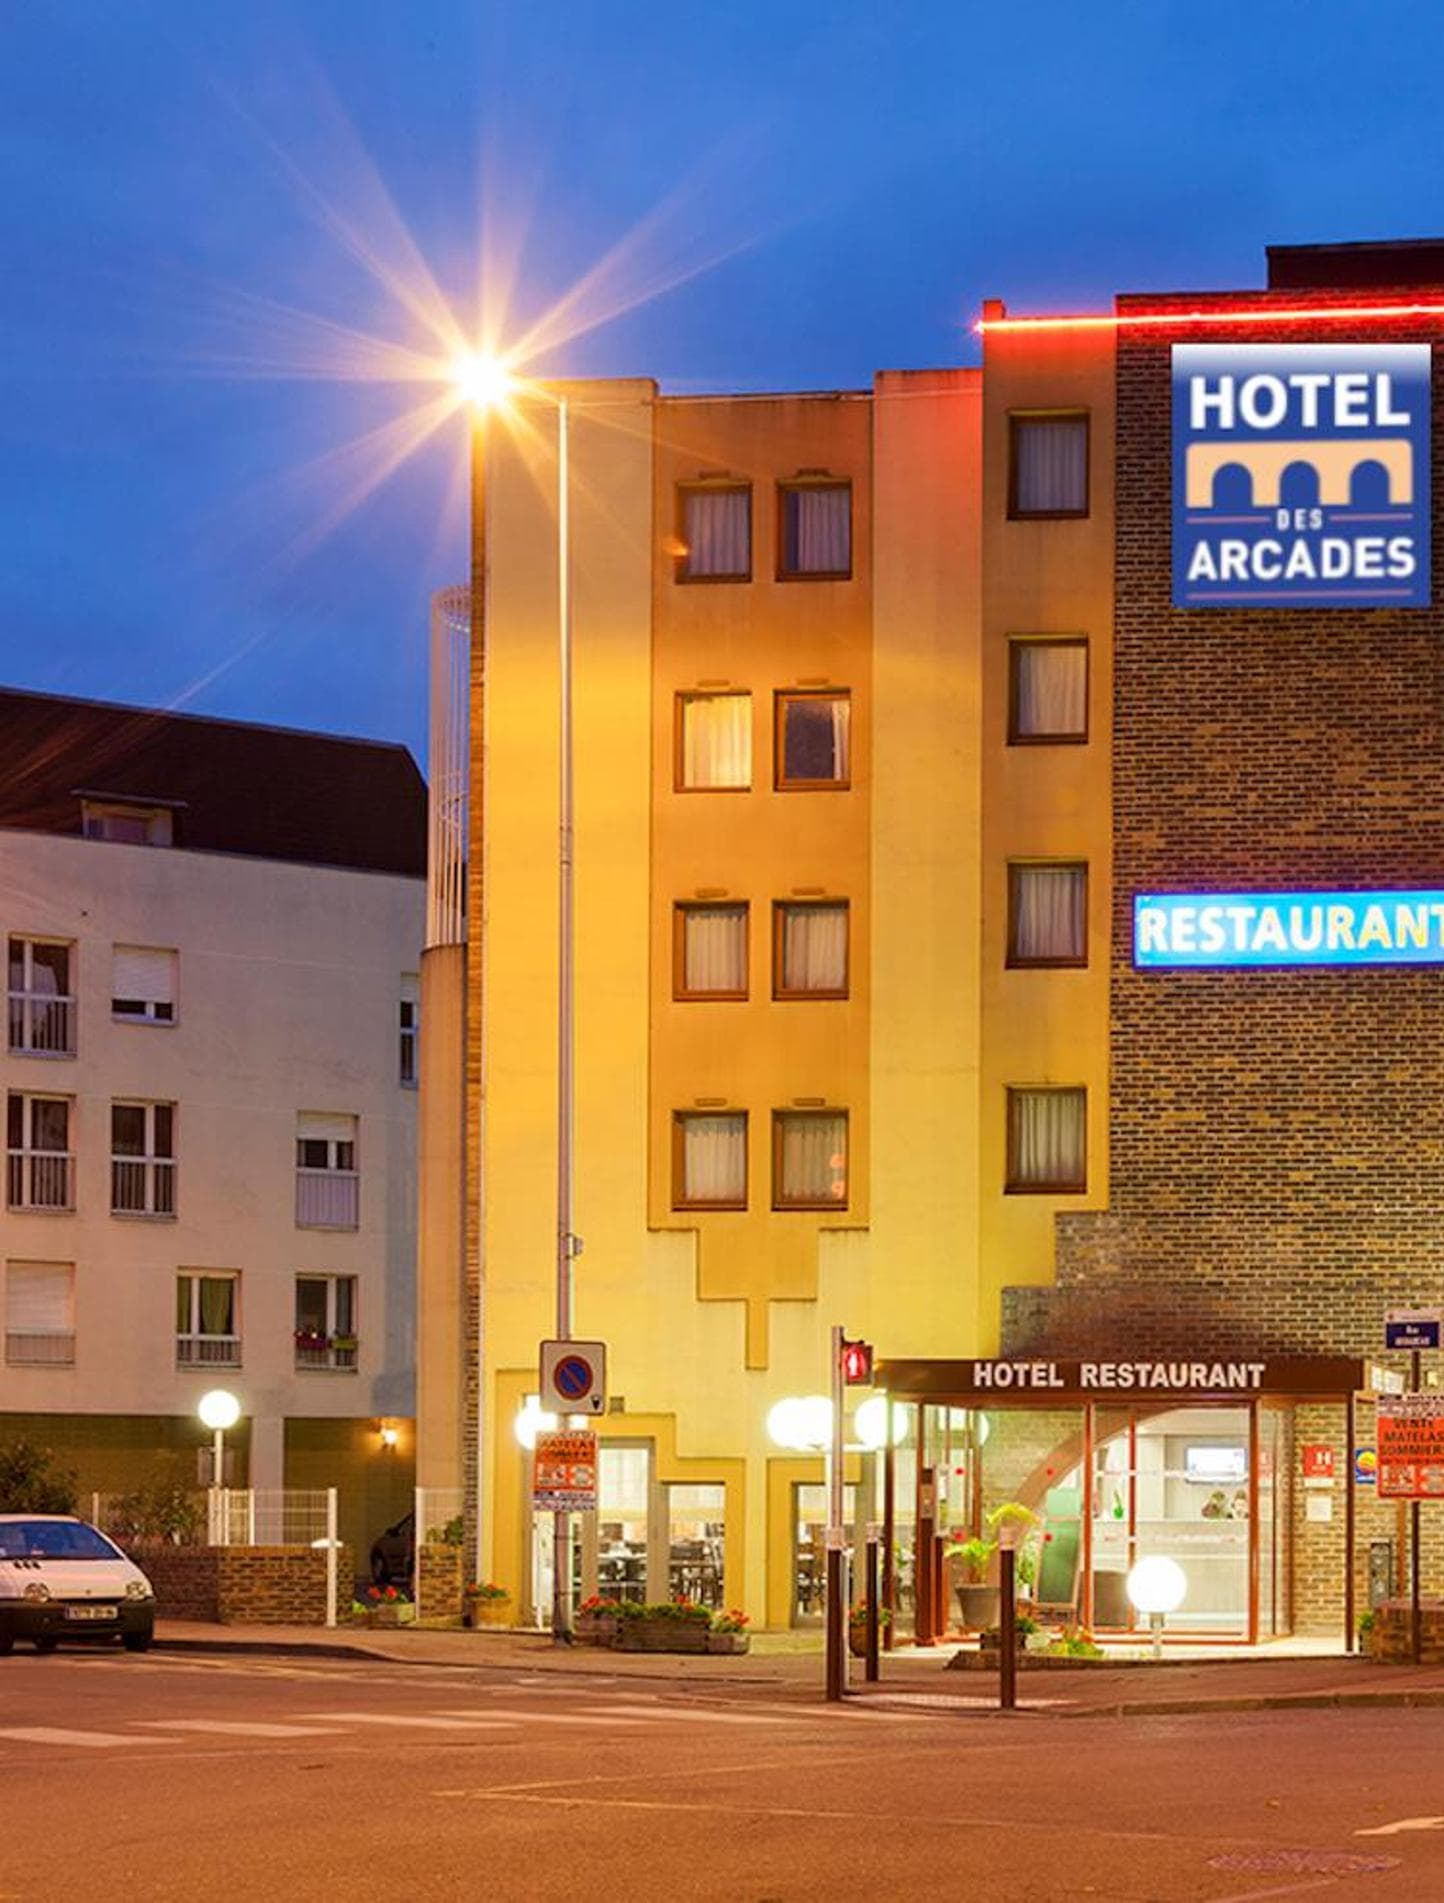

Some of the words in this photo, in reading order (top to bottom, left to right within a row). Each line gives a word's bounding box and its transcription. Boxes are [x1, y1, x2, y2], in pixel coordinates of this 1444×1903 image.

[1190, 373, 1411, 429] HOTEL
[1276, 508, 1323, 531] DES
[1187, 537, 1416, 581] ARCADES
[973, 1363, 1064, 1387] HOTEL
[1080, 1363, 1266, 1387] RESTAURANT
